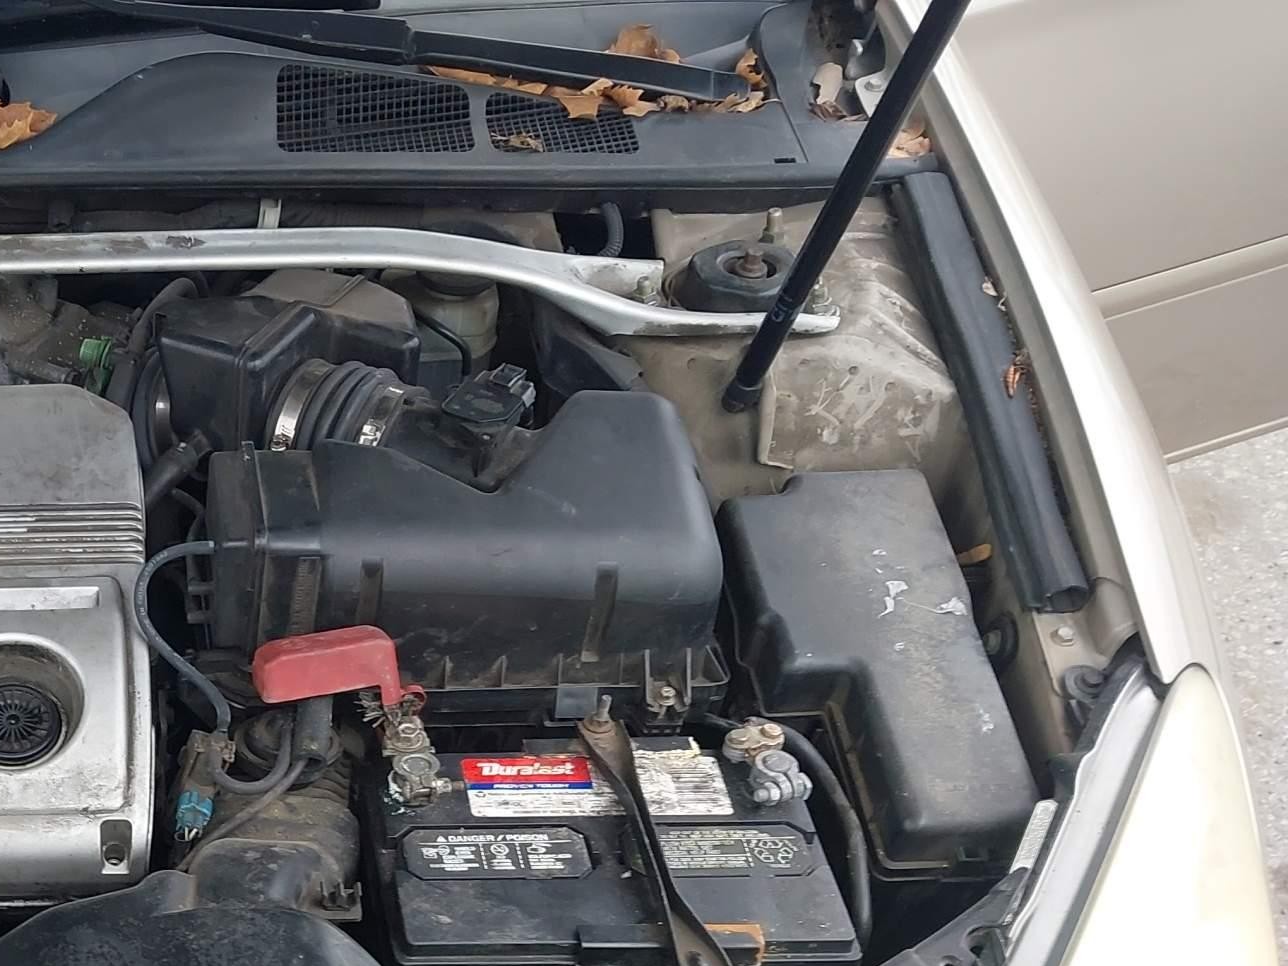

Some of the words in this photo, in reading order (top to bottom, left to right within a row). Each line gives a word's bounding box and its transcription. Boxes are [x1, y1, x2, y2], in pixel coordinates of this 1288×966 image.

[476, 762, 575, 776] Duralast
[448, 834, 495, 843] DANGER
[505, 833, 549, 842] POISON
